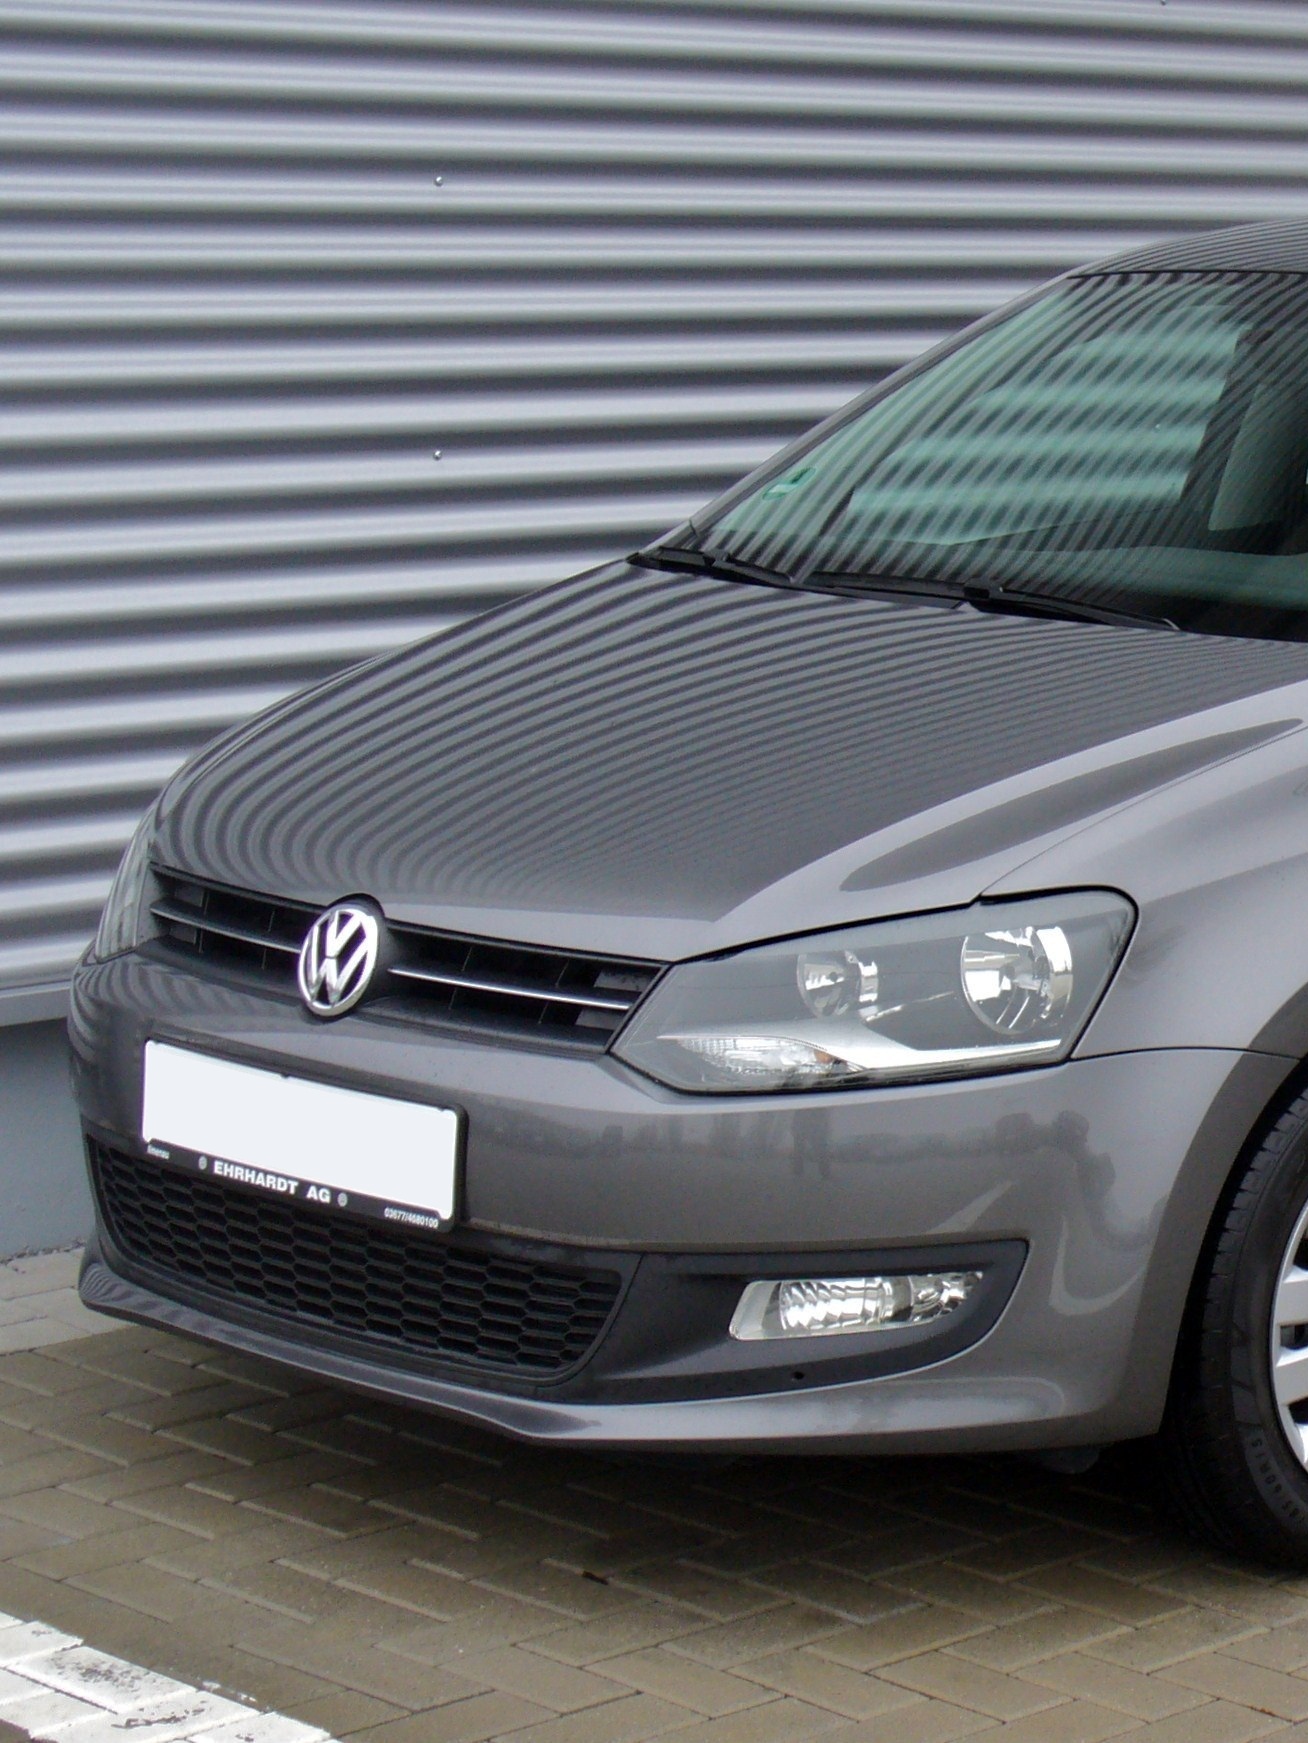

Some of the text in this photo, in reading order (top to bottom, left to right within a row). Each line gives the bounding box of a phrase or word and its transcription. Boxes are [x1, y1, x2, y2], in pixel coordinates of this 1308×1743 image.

[300, 907, 378, 1013] VW
[213, 1160, 331, 1204] EHRHARDT AG
